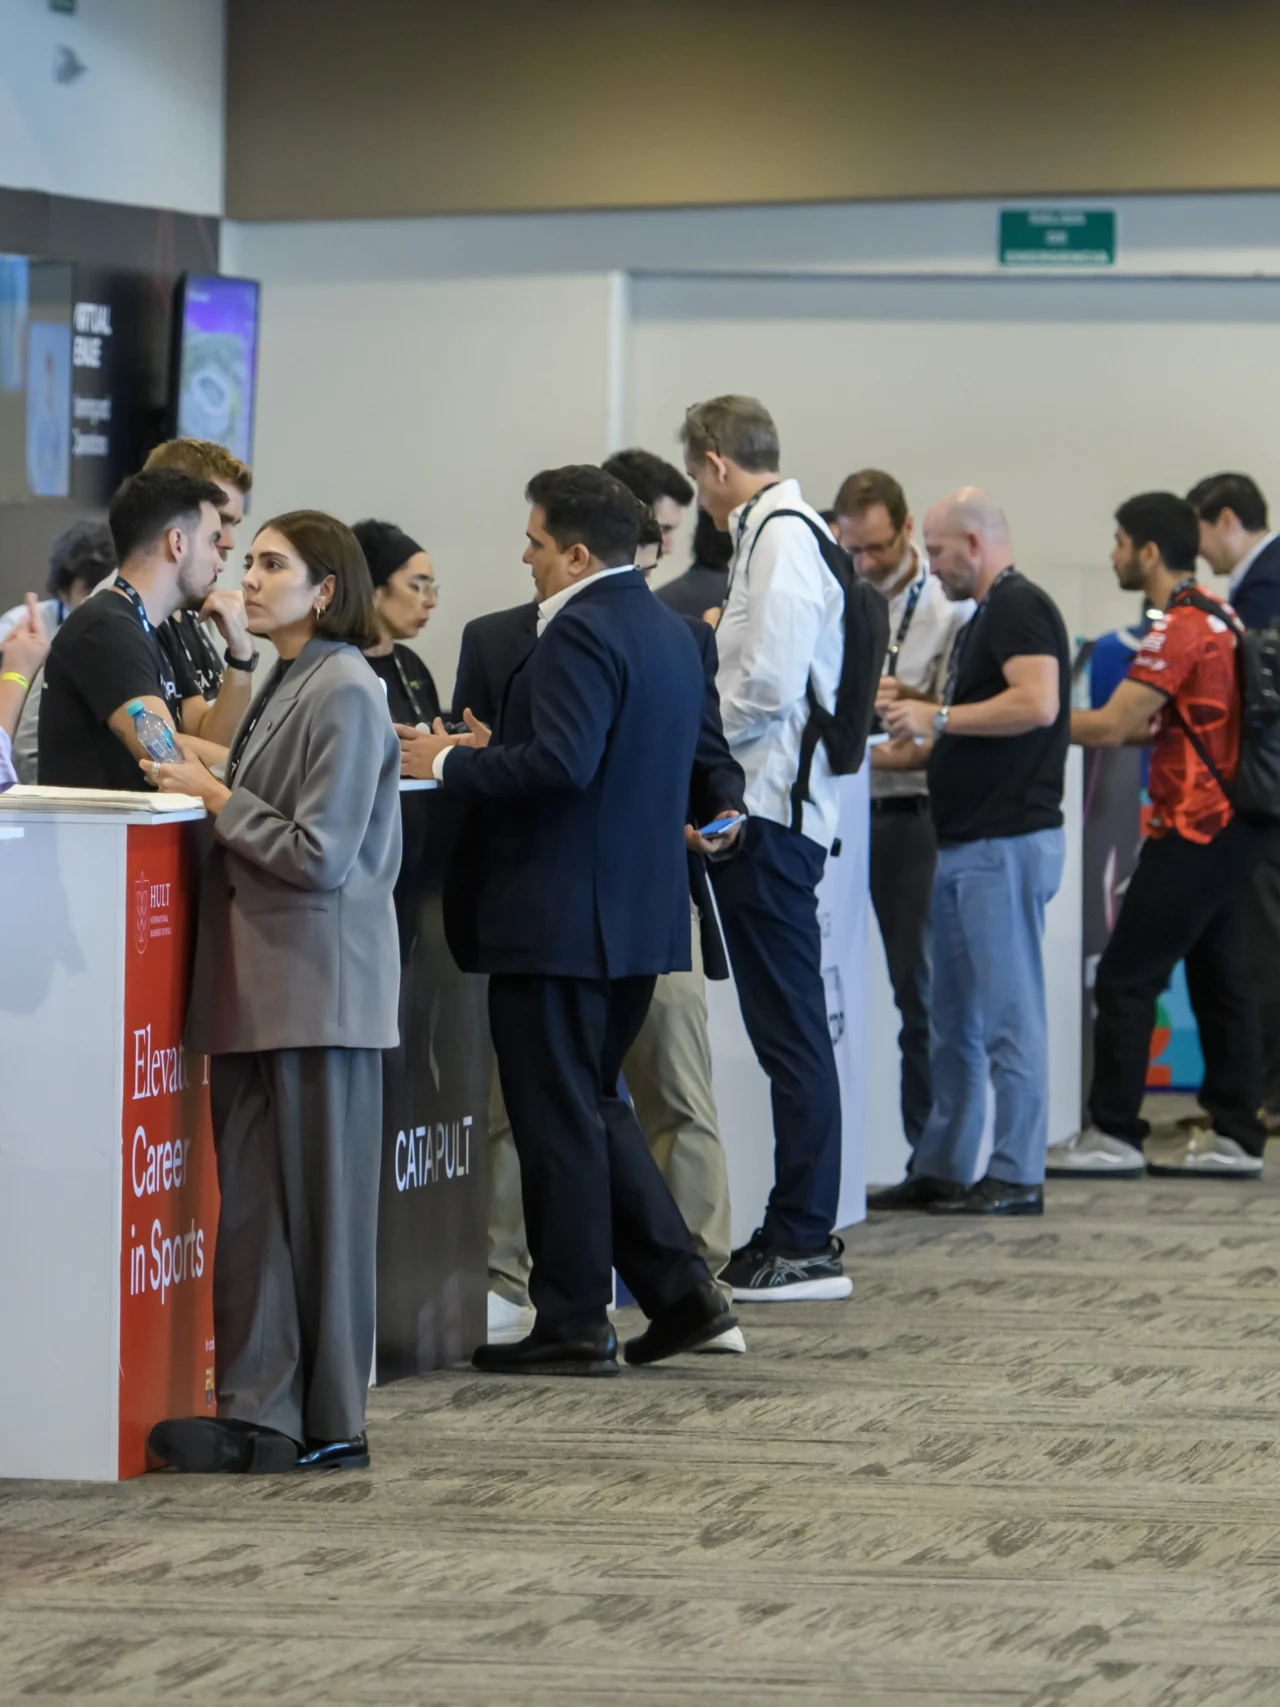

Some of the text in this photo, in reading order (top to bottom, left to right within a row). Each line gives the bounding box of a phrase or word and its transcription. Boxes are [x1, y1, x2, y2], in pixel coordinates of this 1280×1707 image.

[150, 883, 171, 908] HULT
[395, 1115, 473, 1192] CATAPULT
[130, 1217, 205, 1305] in Sports
